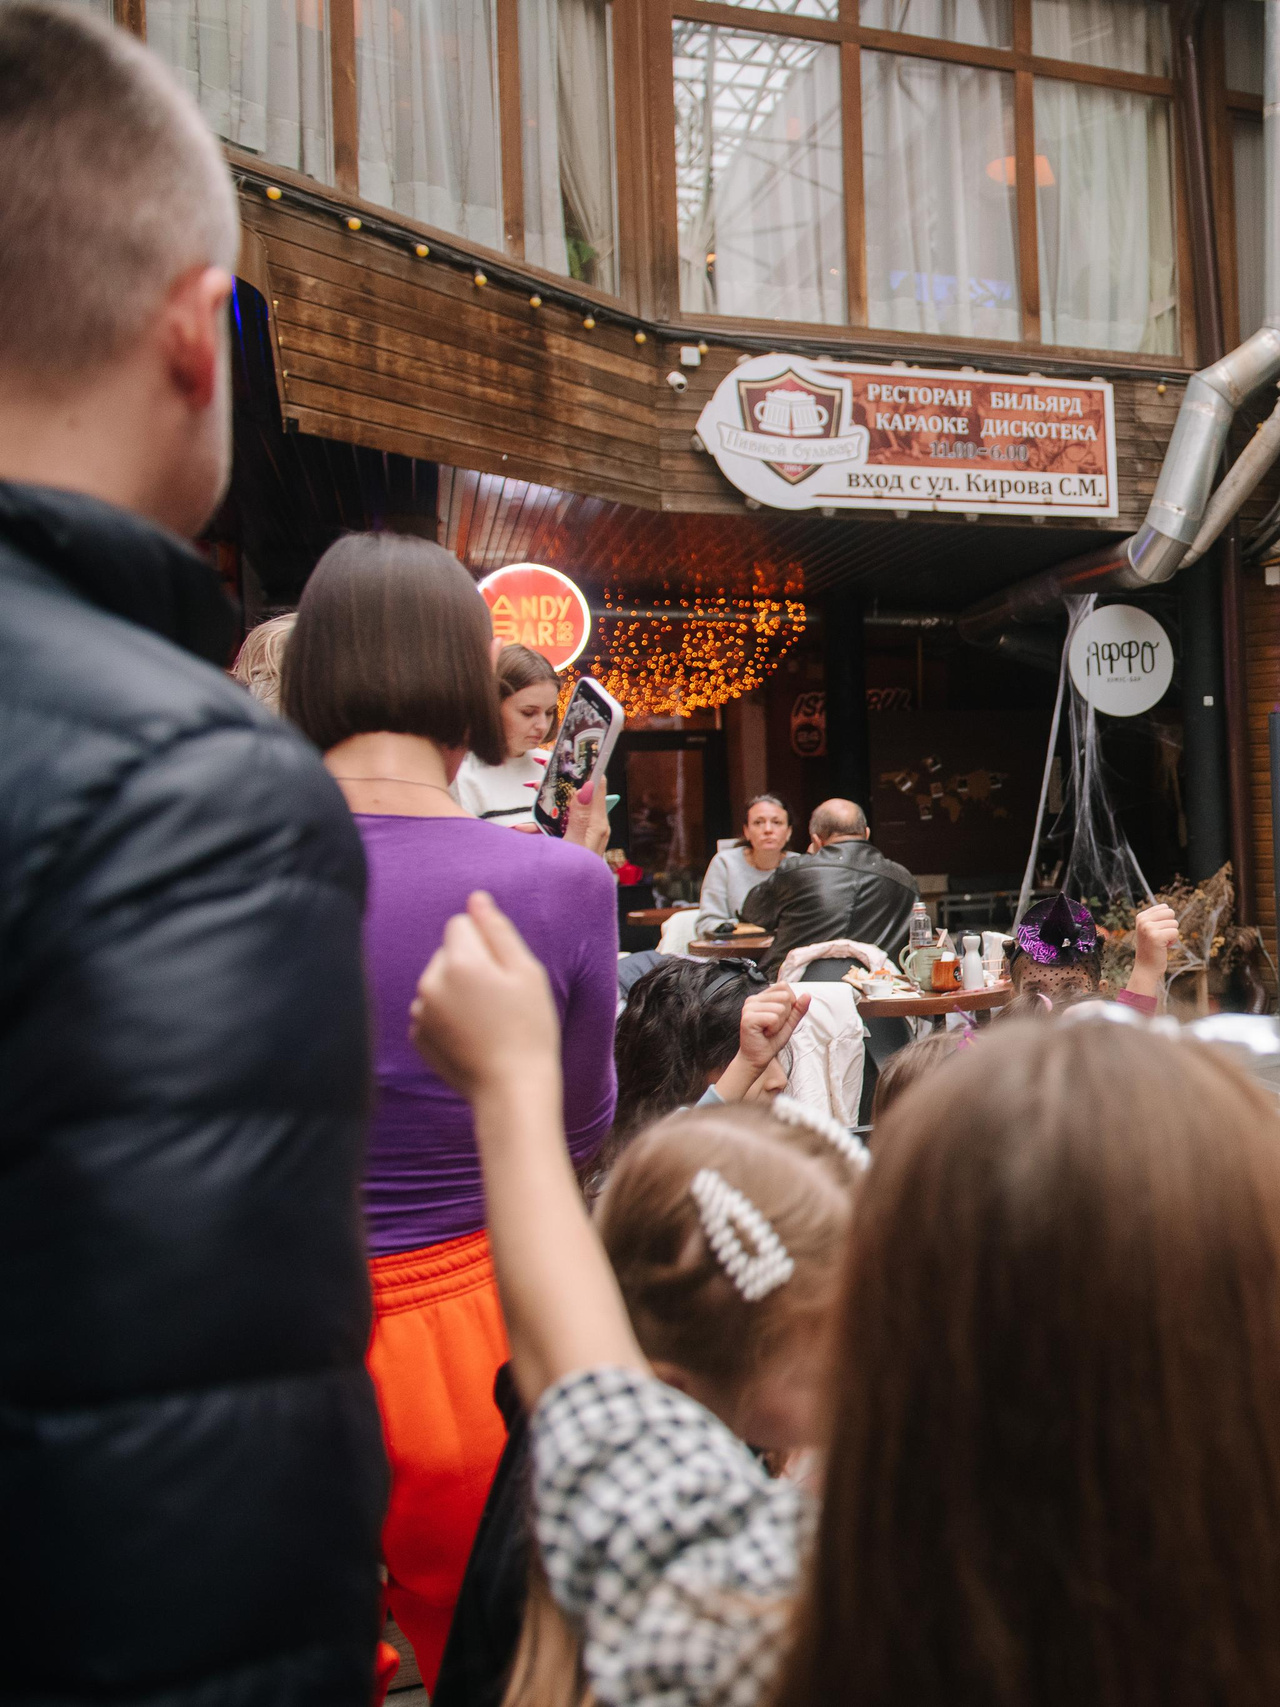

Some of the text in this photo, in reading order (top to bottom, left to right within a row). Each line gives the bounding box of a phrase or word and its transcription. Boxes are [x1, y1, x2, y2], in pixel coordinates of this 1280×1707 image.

[867, 383, 1083, 417] РЕСТОРАН БИЛЬЯРД
[875, 412, 1098, 441] КАРАОКЕ ДИСКОТЕКА
[725, 430, 855, 461] Пивной бульвар
[847, 473, 1103, 498] вход с ул. Кирова С.М.
[491, 595, 572, 620] ANDY
